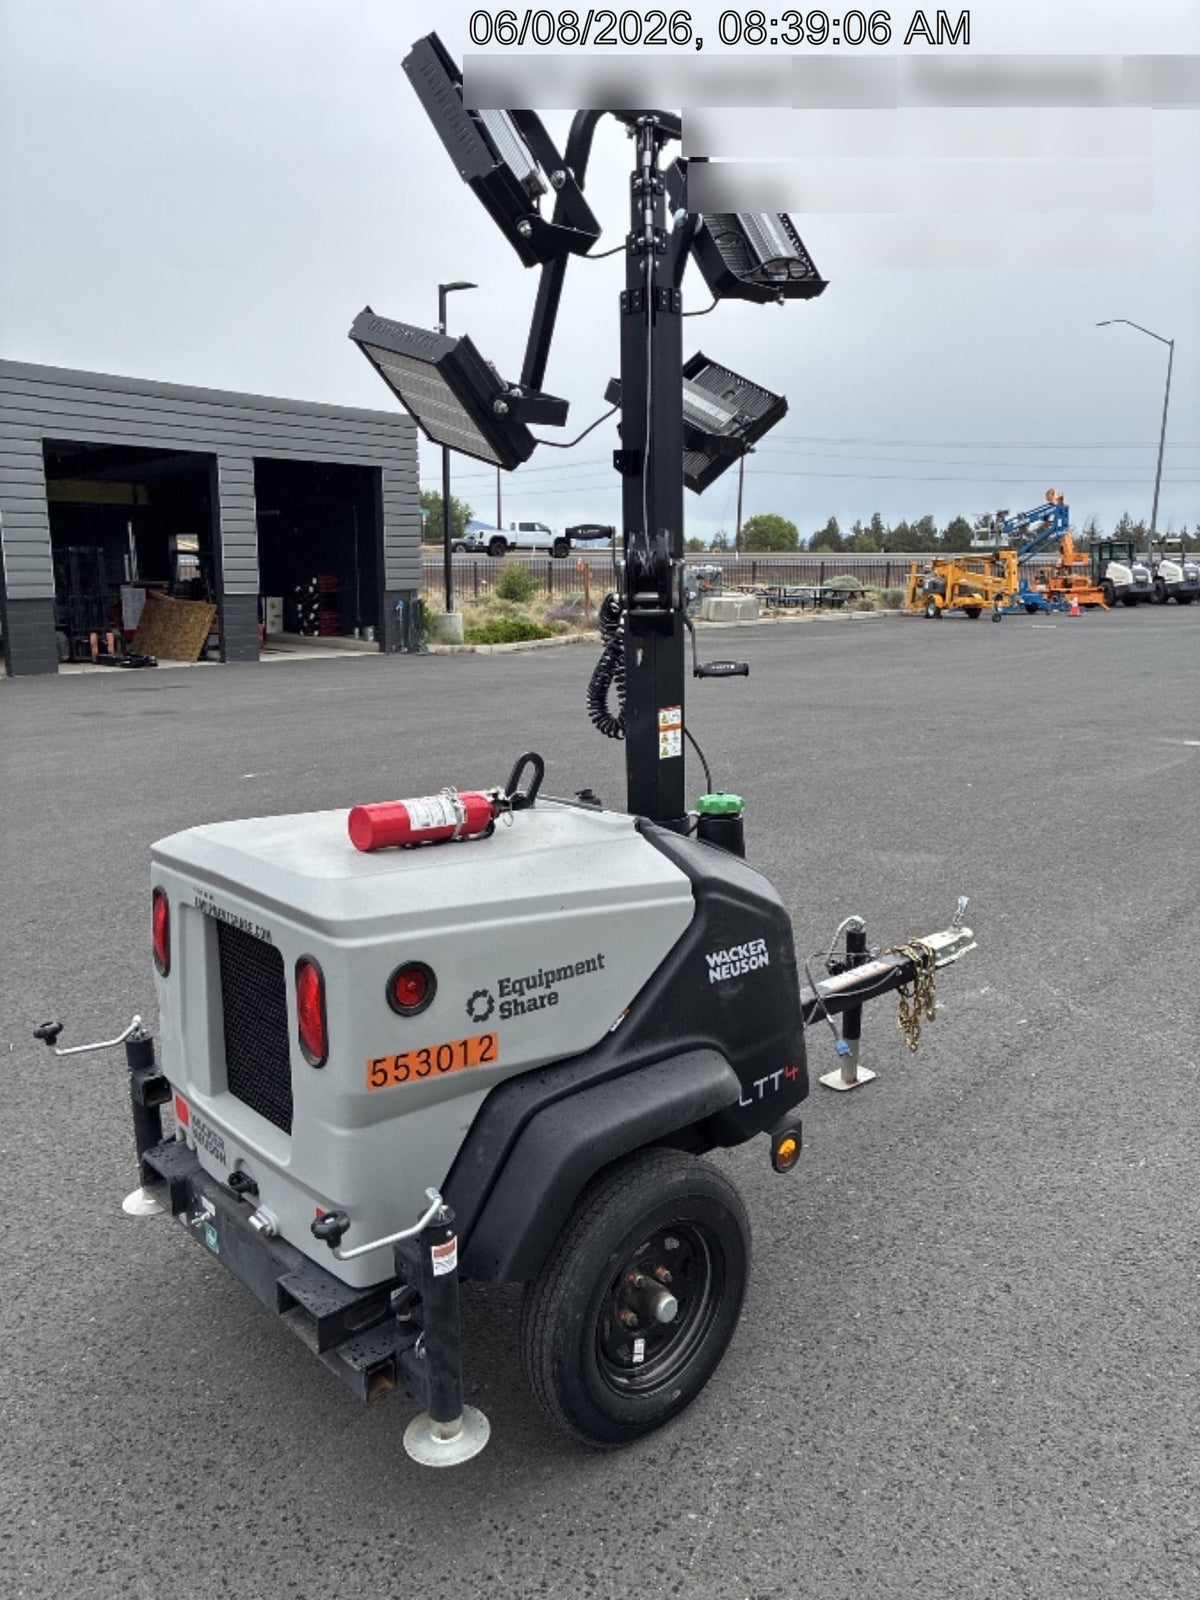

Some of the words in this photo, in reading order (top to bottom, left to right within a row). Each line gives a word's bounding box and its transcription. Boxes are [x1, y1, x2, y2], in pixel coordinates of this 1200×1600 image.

[705, 938, 767, 968] WACKER
[708, 953, 769, 984] NEUSON
[498, 953, 605, 997] Equipment
[499, 991, 559, 1020] Share
[371, 1035, 493, 1087] 553012
